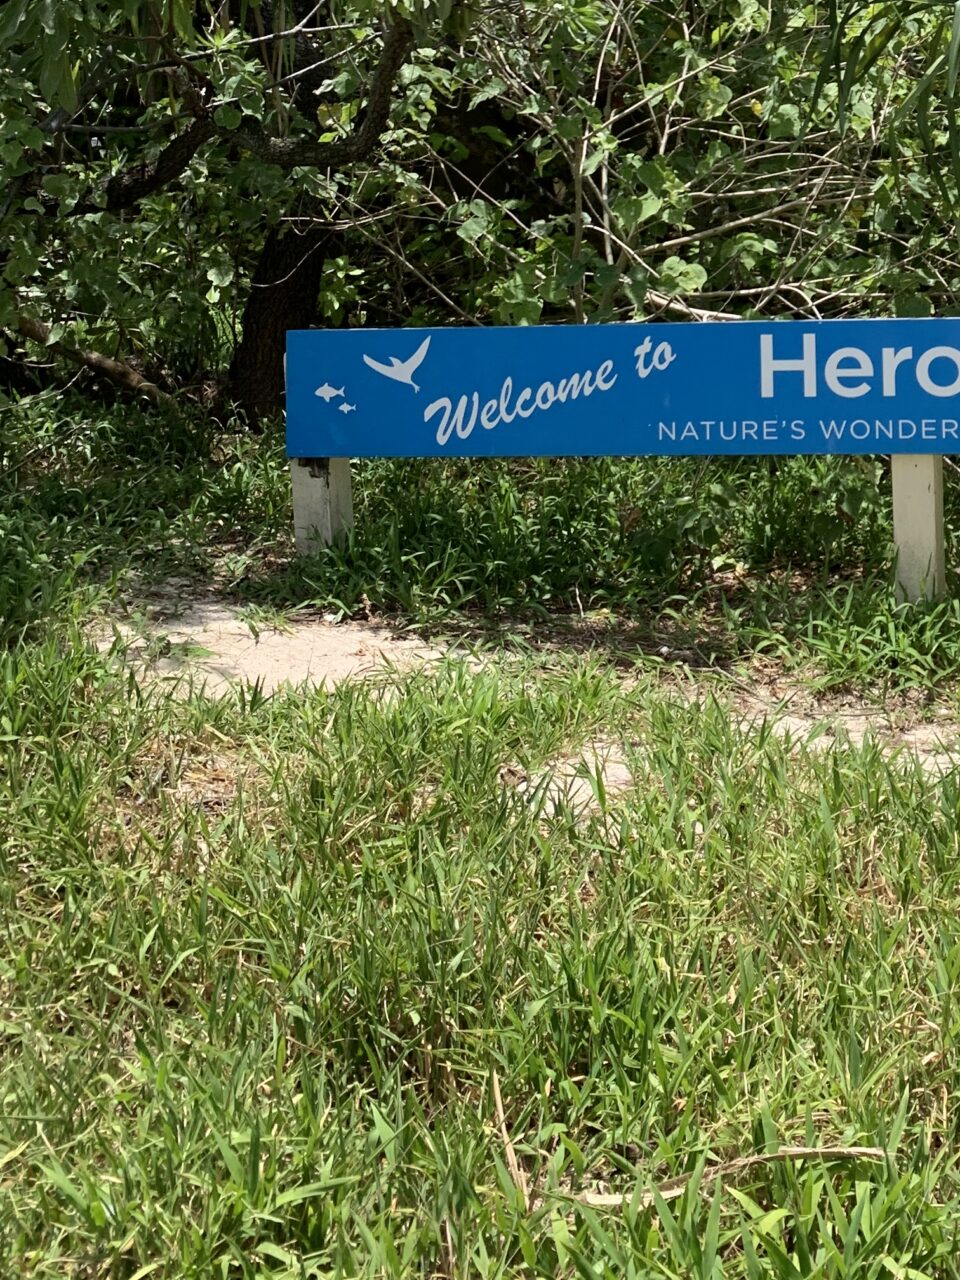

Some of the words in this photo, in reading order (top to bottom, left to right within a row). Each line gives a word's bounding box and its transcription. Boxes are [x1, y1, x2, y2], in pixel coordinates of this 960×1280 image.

[423, 360, 618, 446] Welcome
[634, 335, 677, 379] to
[657, 420, 806, 441] NATURE'S
